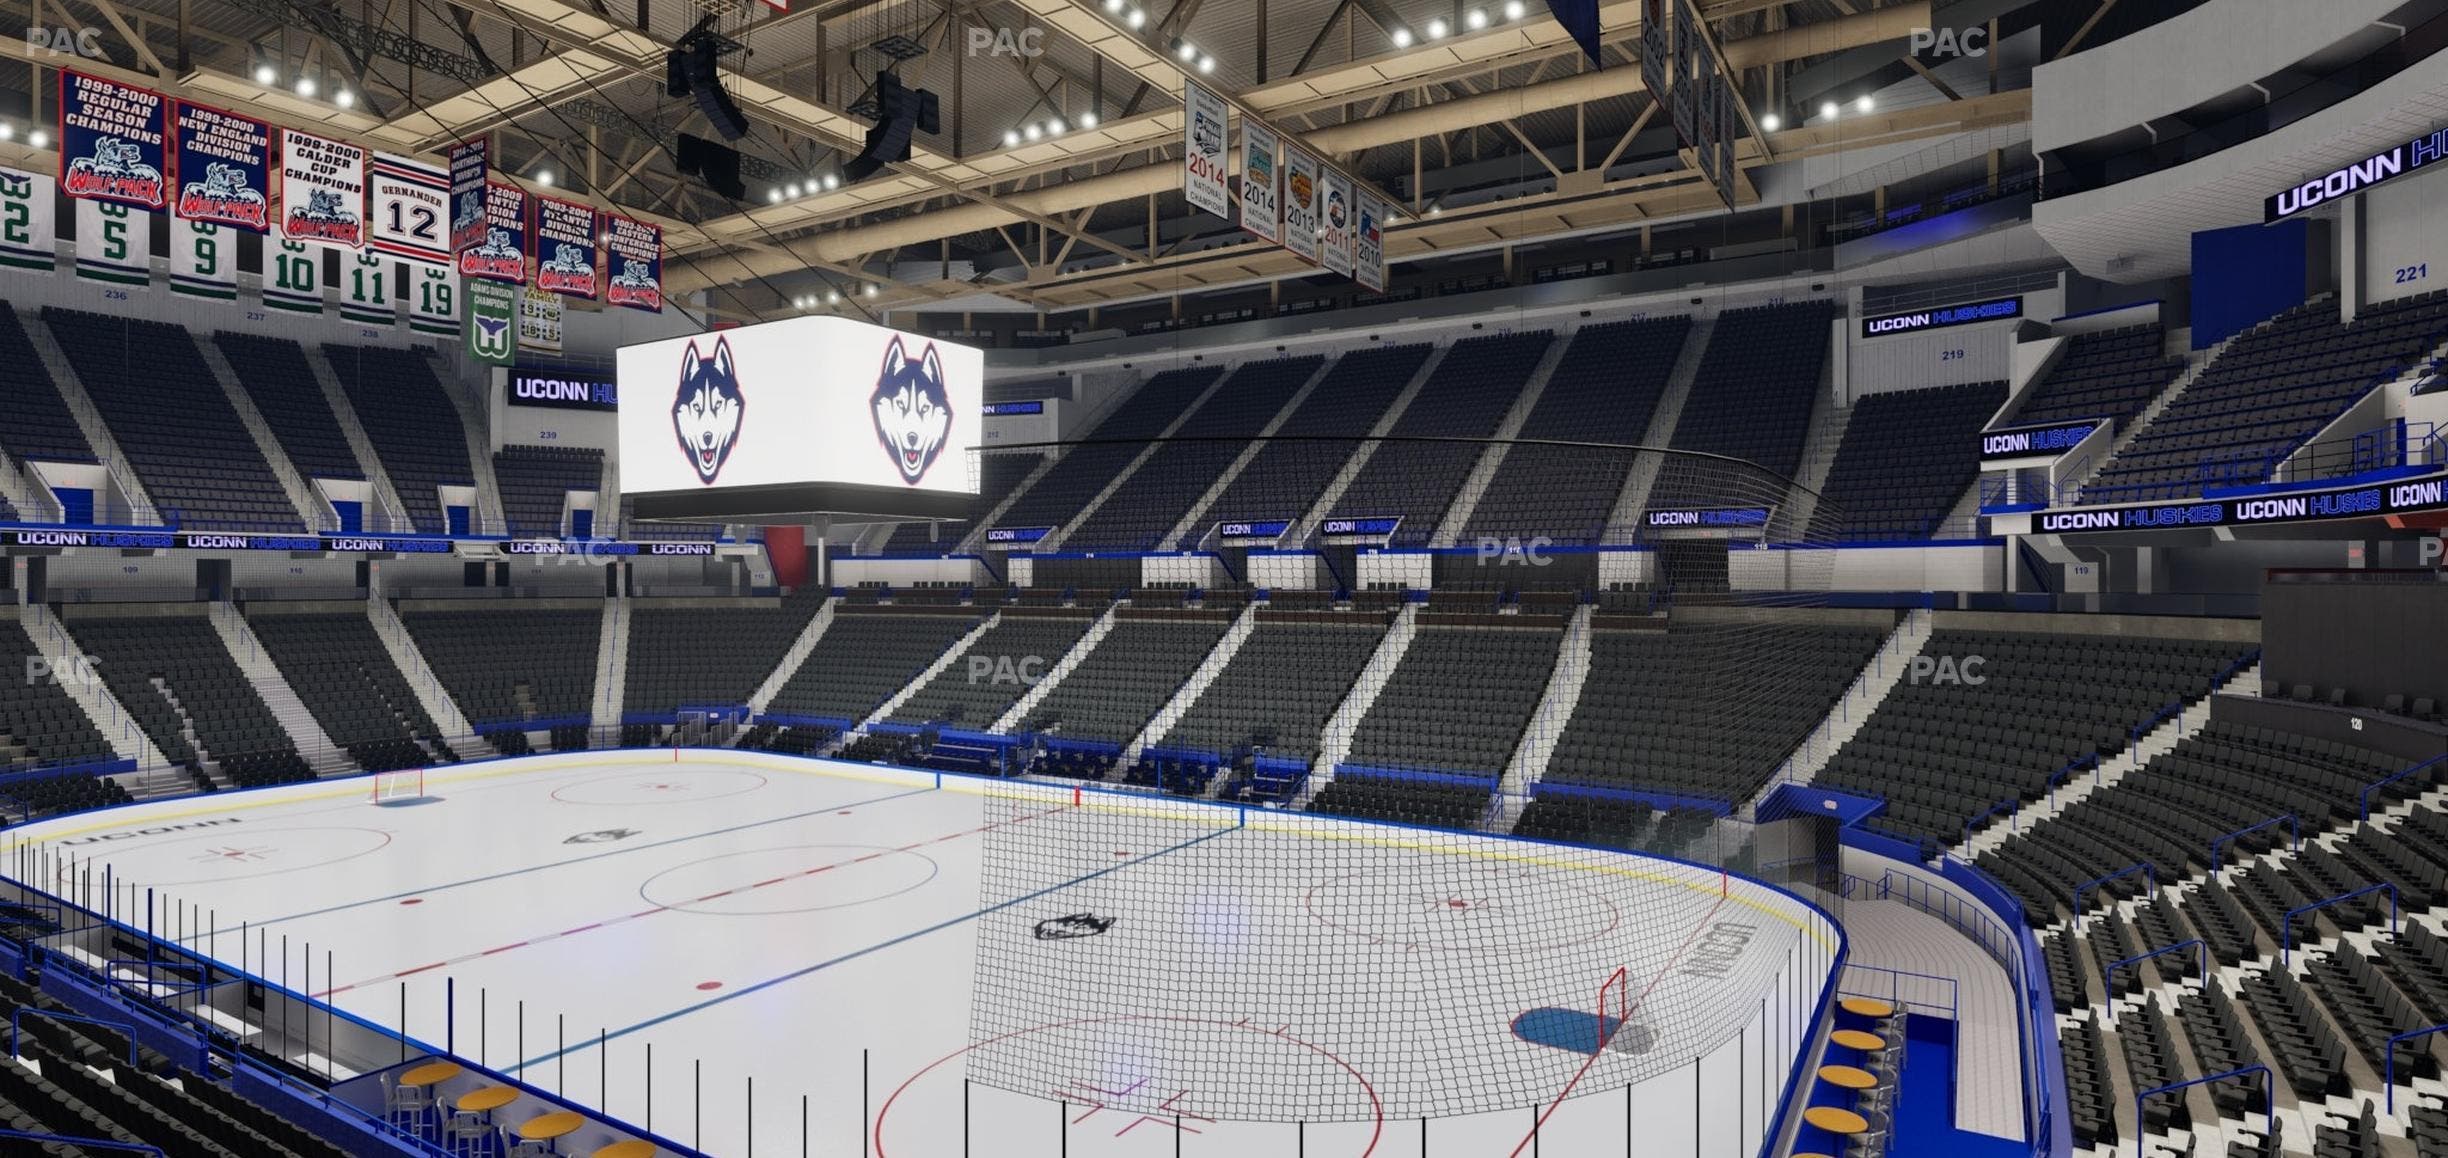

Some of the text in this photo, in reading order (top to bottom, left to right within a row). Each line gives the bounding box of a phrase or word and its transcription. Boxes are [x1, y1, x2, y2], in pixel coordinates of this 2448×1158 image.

[75, 76, 158, 106] 1999-2000
[77, 90, 152, 118] REGULAR
[82, 104, 147, 129] SEASON
[191, 108, 254, 132] 1999-2000
[66, 113, 162, 145] CHAMPIONS
[178, 117, 267, 147] NEW ENGLAND
[186, 140, 260, 165] CHAMPIONS
[196, 132, 251, 153] DIVISION
[287, 133, 361, 160] 1999-2000
[296, 148, 351, 168] CALDER
[310, 162, 337, 175] CUP
[1189, 152, 1225, 188] 2014
[285, 168, 362, 193] CHAMPIONS
[1193, 179, 1223, 200] NATIONAL
[2278, 147, 2402, 216] UCONN
[382, 185, 442, 207] GERNANDER
[487, 194, 520, 210] ANTIC
[1244, 182, 1275, 213] 2014
[4, 201, 30, 244] 2
[387, 200, 438, 242] 12
[487, 204, 517, 219] ISION
[1287, 205, 1315, 234] 2013
[104, 220, 127, 260] 5
[539, 228, 595, 248] CHAMPIONS
[608, 233, 660, 252] CONFERENCE
[616, 226, 653, 242] EASTERN
[1325, 225, 1349, 250] 2011
[195, 238, 216, 275] 9
[611, 242, 658, 260] CHAMPIONS
[1359, 243, 1381, 268] 2010
[275, 254, 314, 293] 10
[2395, 263, 2428, 284] 221
[105, 290, 127, 301] 236
[352, 268, 385, 304] 11
[420, 281, 452, 315] 19
[246, 312, 265, 321] 237
[1869, 300, 2017, 333] UCONN HUSKIES
[1942, 349, 1964, 361] 219
[516, 378, 589, 402] UCONN
[540, 430, 557, 440] 239
[1983, 433, 2029, 454] UCONN
[2044, 511, 2119, 530] UCONN
[2125, 504, 2223, 526] HUSKIES
[2237, 498, 2306, 520] UCONN
[2311, 489, 2381, 515] HUSKIES
[2390, 481, 2441, 507] UCONN
[1222, 524, 1251, 535] UCONN
[1324, 521, 1355, 533] UCONN
[1650, 512, 1699, 525] UCONN
[18, 533, 87, 546] UCONN
[187, 535, 247, 548] UCONN
[332, 539, 383, 551] UCONN
[510, 542, 565, 554] UCONN
[651, 543, 711, 555] UCONN
[2073, 566, 2089, 576] 119
[2351, 717, 2363, 731] 120
[61, 817, 242, 845] UCONN
